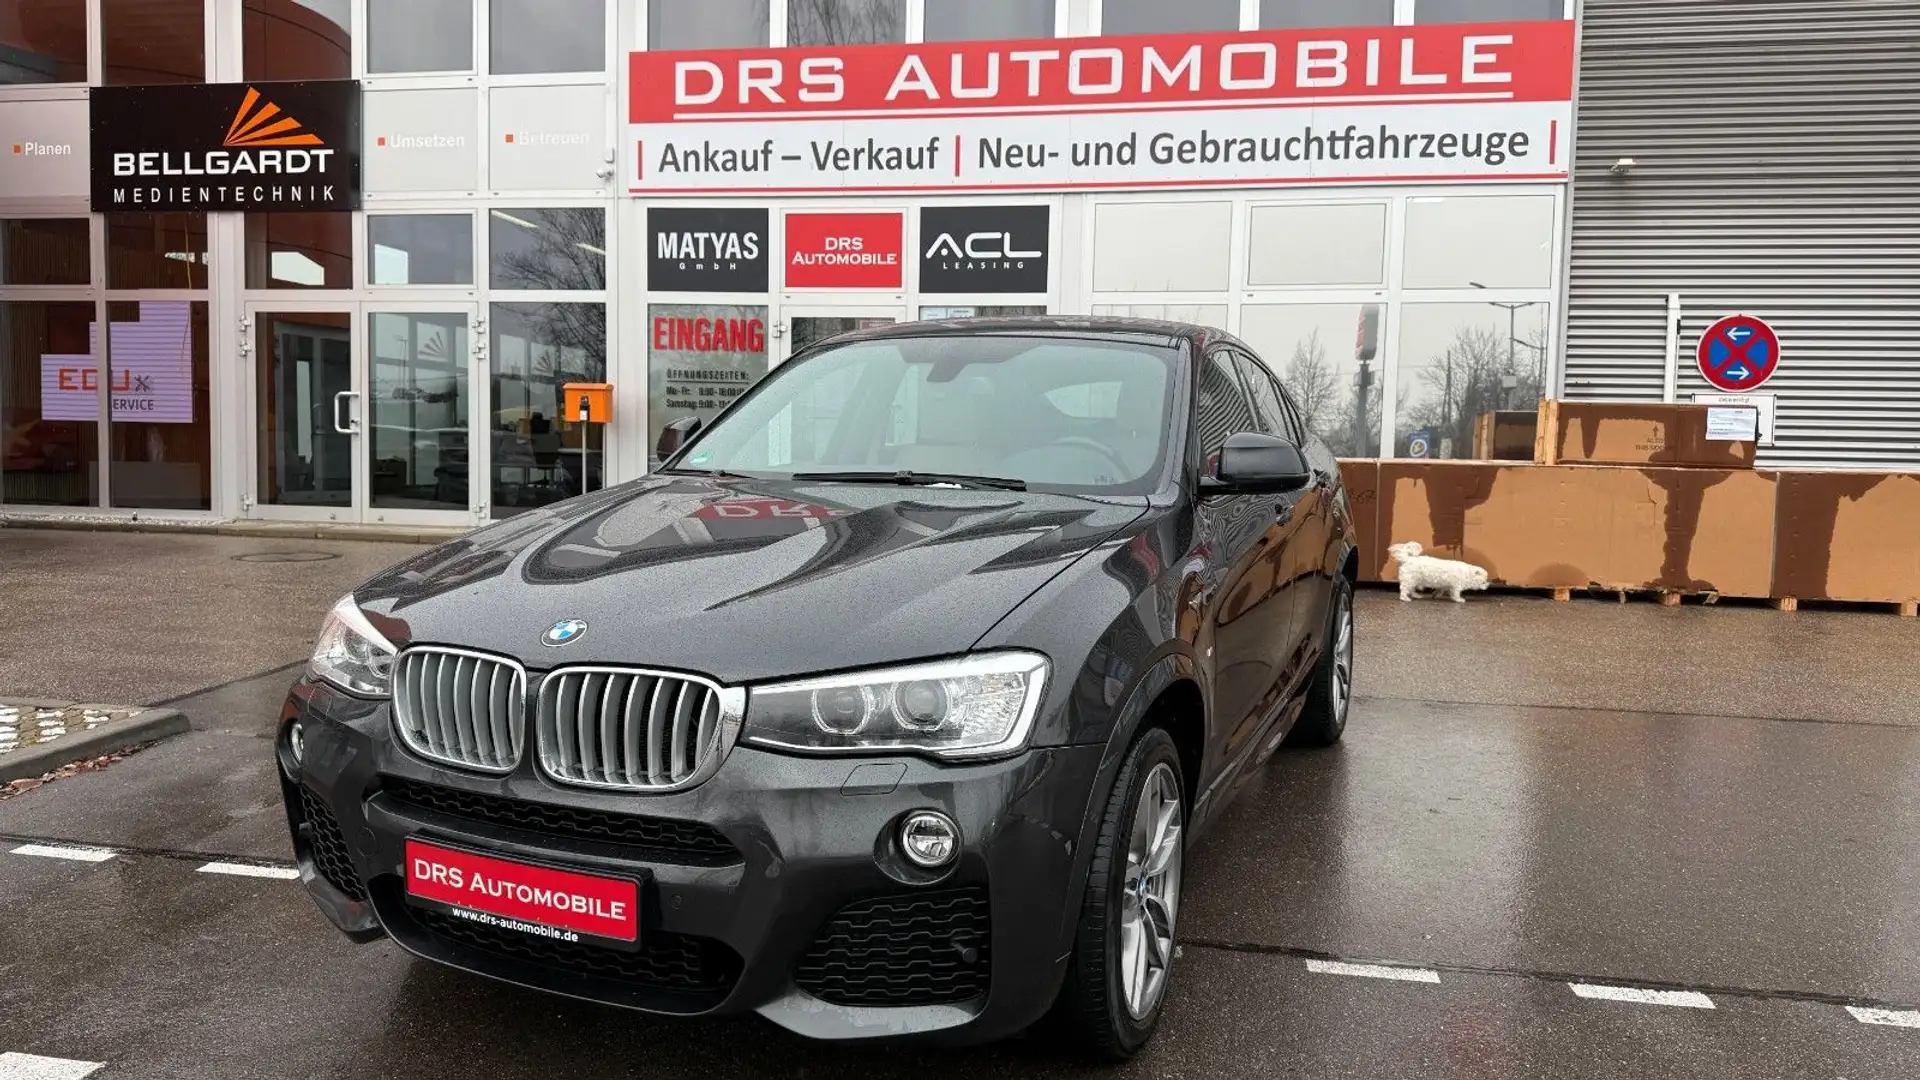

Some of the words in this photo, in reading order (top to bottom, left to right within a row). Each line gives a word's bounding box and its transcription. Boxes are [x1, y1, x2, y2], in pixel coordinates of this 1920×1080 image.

[675, 56, 844, 106] DRS
[885, 34, 1513, 101] AUTOMOBILE
[24, 141, 71, 157] Planen
[390, 133, 466, 148] Umsetzen
[519, 131, 590, 146] Betreuen
[658, 138, 773, 173] Ankauf
[811, 136, 939, 172] Verkauf
[978, 137, 1059, 168] Neu-
[1071, 132, 1136, 166] und
[1149, 125, 1529, 166] Gebrauchtfahrzeuge
[113, 149, 335, 176] BELLGARDT
[113, 184, 335, 204] MEDIENTECHNIK
[657, 231, 759, 260] MATYAS
[824, 236, 864, 251] DRS
[925, 231, 1043, 260] ACL
[679, 262, 736, 270] GmbH
[943, 261, 1025, 270] LEASING
[653, 317, 765, 352] EINGANG
[111, 398, 154, 411] ERVICE
[414, 858, 464, 889] DRS
[452, 906, 579, 943] www.drs-automobile.de
